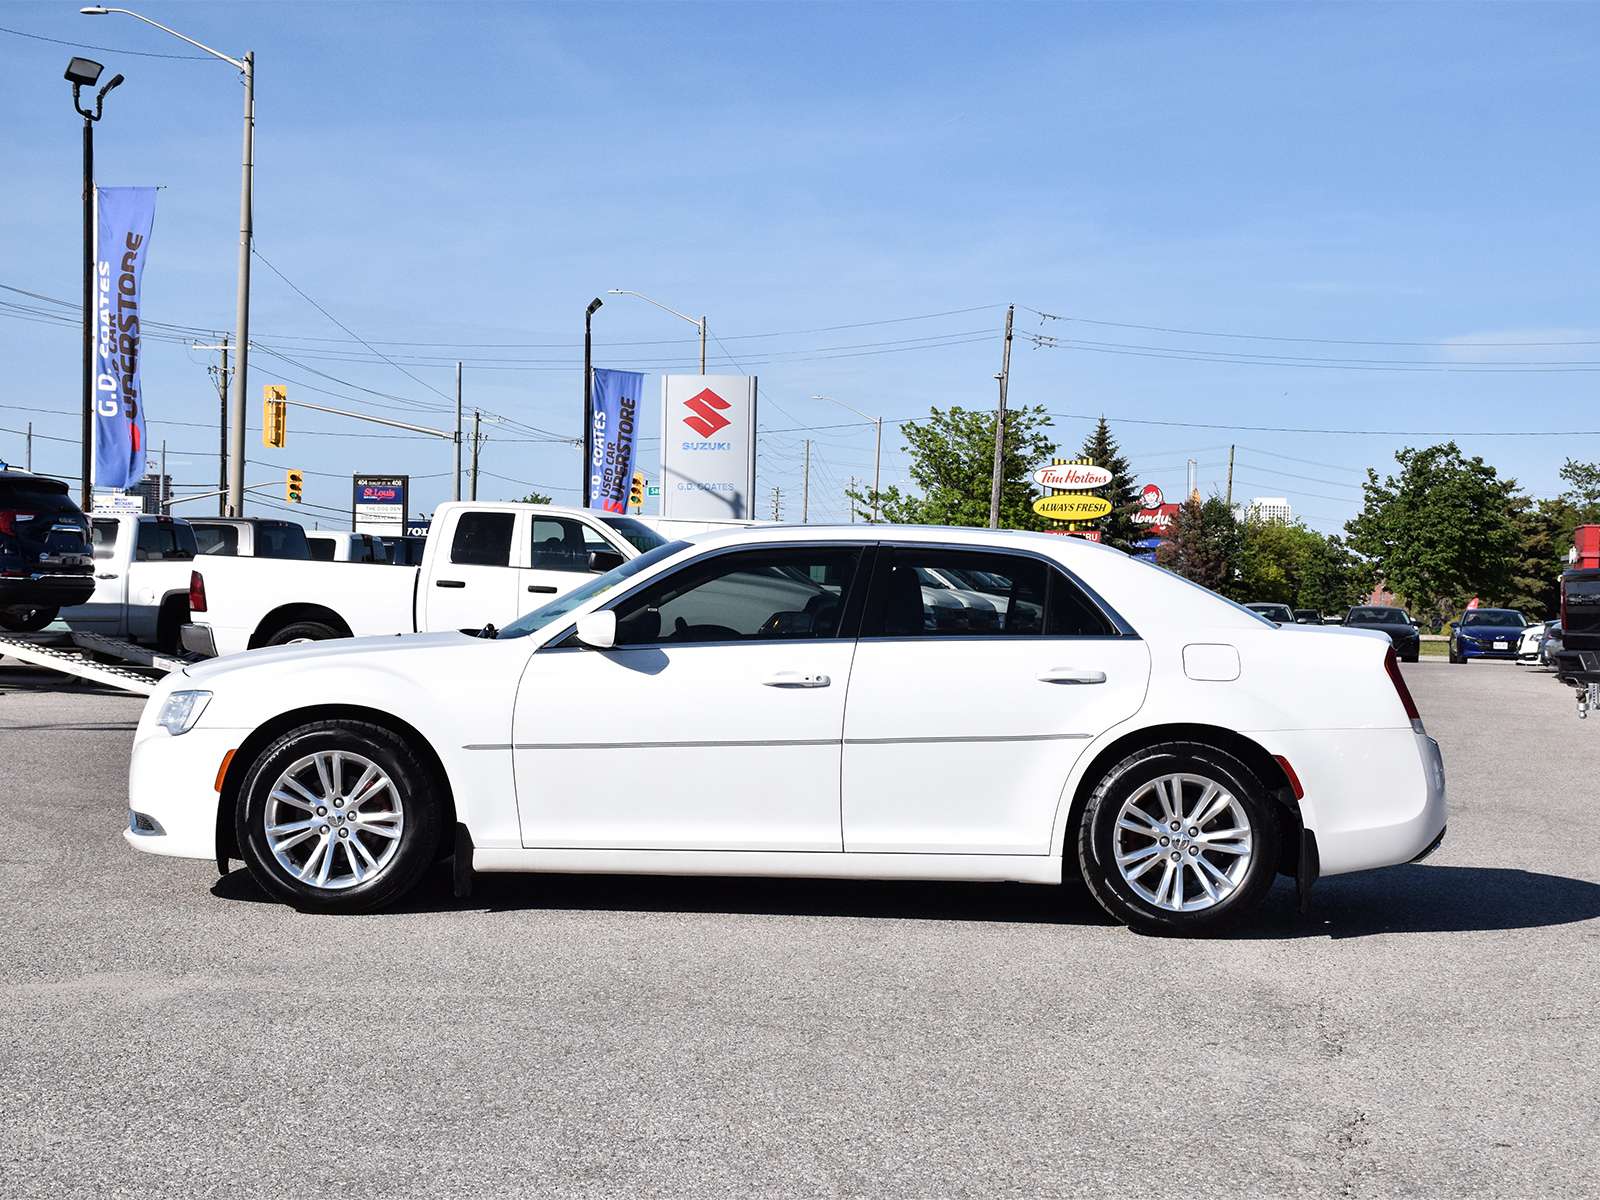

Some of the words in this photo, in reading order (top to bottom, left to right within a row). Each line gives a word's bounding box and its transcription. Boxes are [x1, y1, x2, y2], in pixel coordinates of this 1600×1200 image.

[593, 410, 606, 467] COATES
[682, 441, 731, 450] SUZUKI
[605, 442, 616, 466] CAR
[600, 468, 613, 497] USED
[1041, 469, 1063, 484] Tim
[1064, 469, 1107, 484] Hortons
[1039, 503, 1075, 512] ALWAYS
[1076, 503, 1107, 512] FRESH
